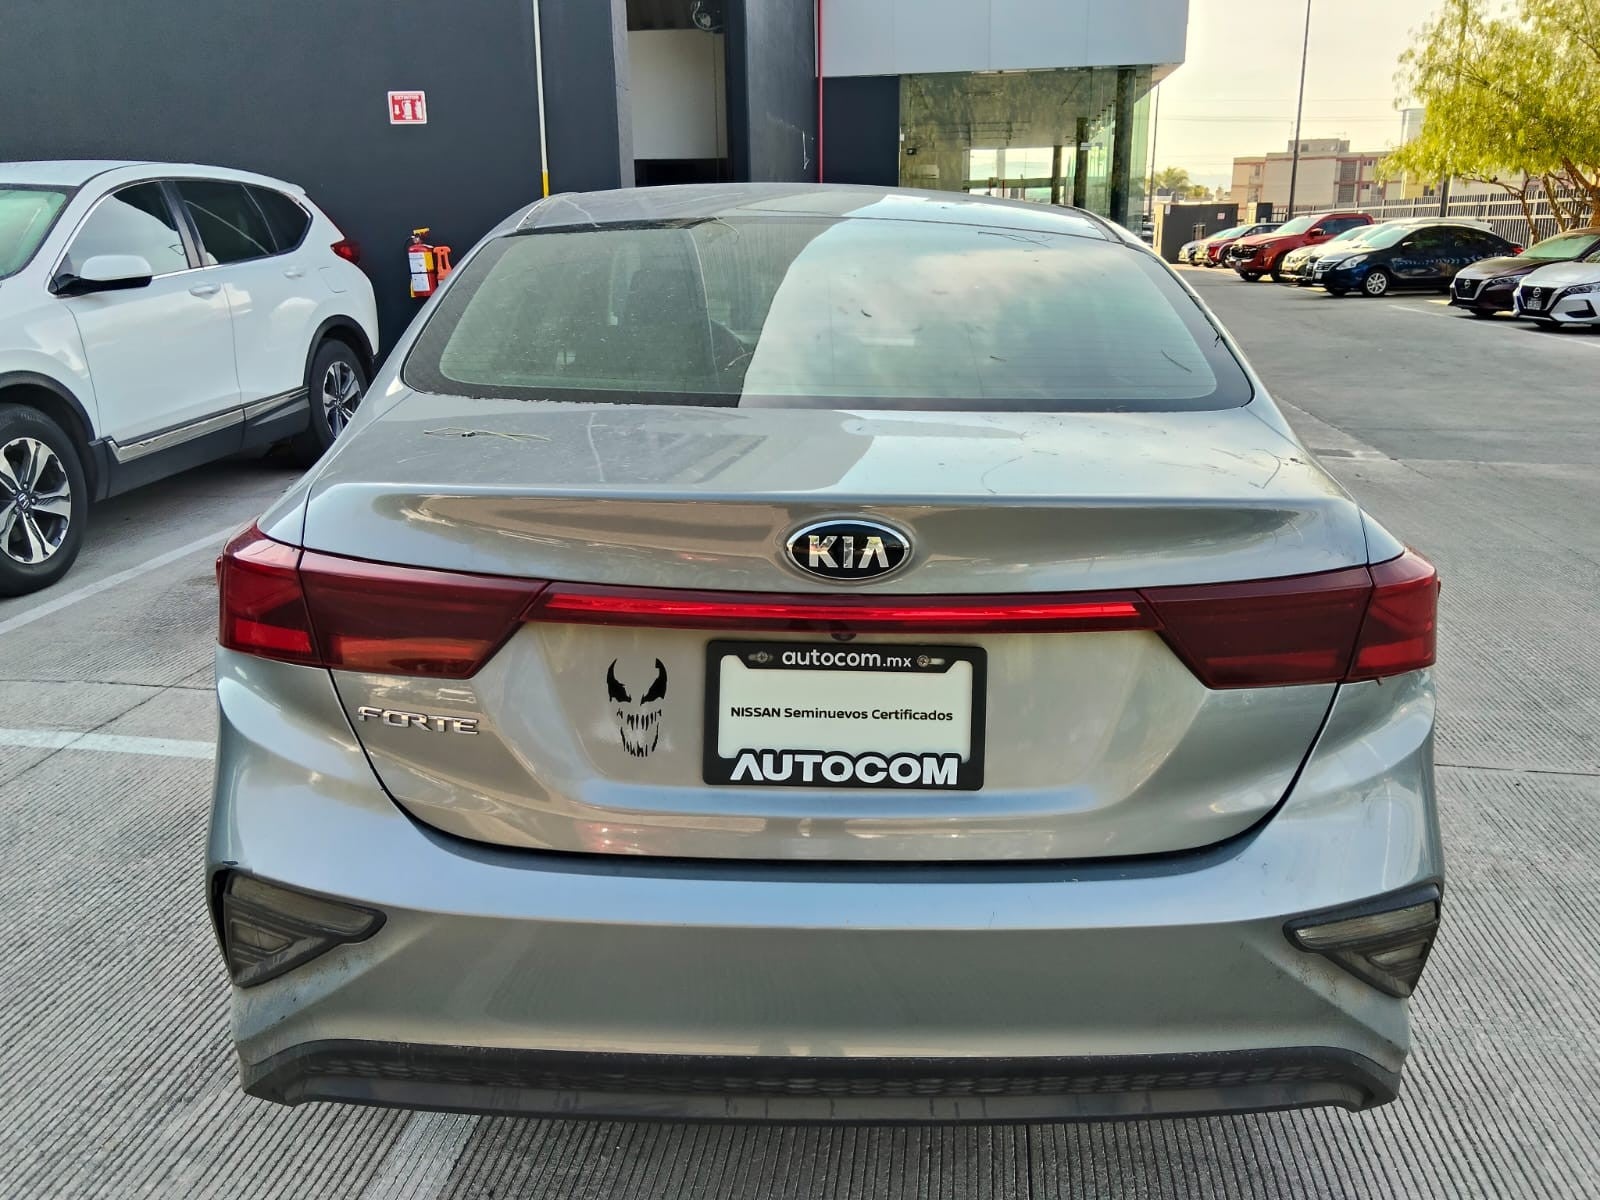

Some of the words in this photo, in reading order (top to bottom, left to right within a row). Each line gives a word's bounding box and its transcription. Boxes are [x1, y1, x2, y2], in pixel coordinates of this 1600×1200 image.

[808, 535, 889, 568] KIA
[782, 649, 912, 667] autocom.mx
[358, 706, 479, 735] FORTE
[731, 707, 780, 718] NISSAN
[784, 708, 868, 719] Seminuevos
[872, 709, 953, 721] Certificados
[730, 753, 958, 785] AUTOCOM
